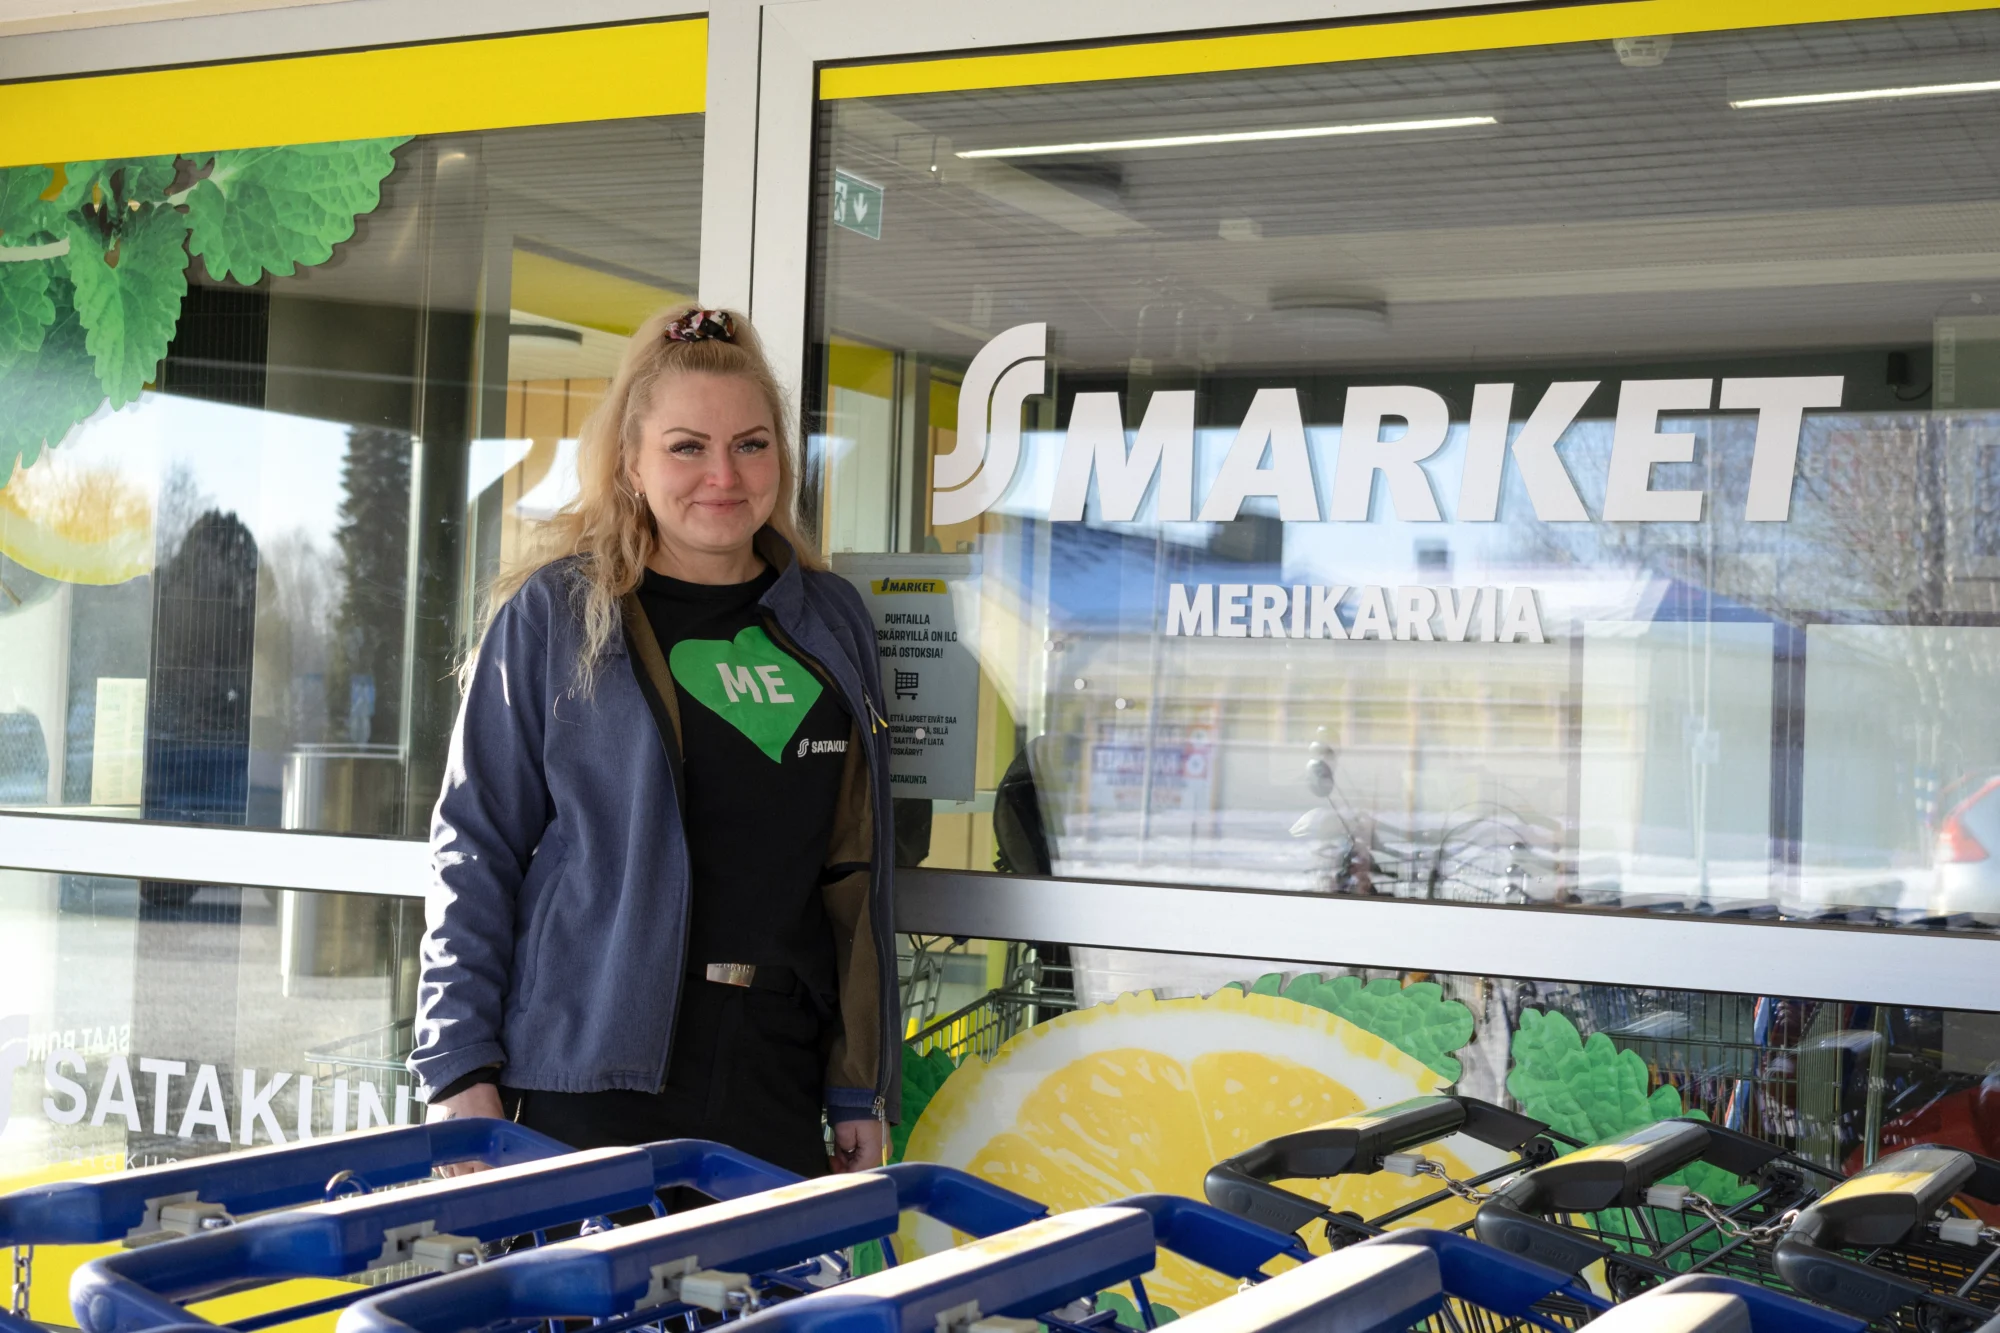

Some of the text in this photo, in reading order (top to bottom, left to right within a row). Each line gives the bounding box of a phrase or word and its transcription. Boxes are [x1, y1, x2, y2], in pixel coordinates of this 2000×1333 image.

[1165, 583, 1545, 643] MERIKARVIA
[884, 613, 930, 625] PUHTAILLA
[931, 631, 943, 642] ON
[899, 647, 943, 658] OSTOKSIA!
[715, 662, 795, 703] ME
[890, 714, 957, 724] ETTÄ LAPSET EIVÄT SAA
[933, 726, 949, 735] SILLÄ
